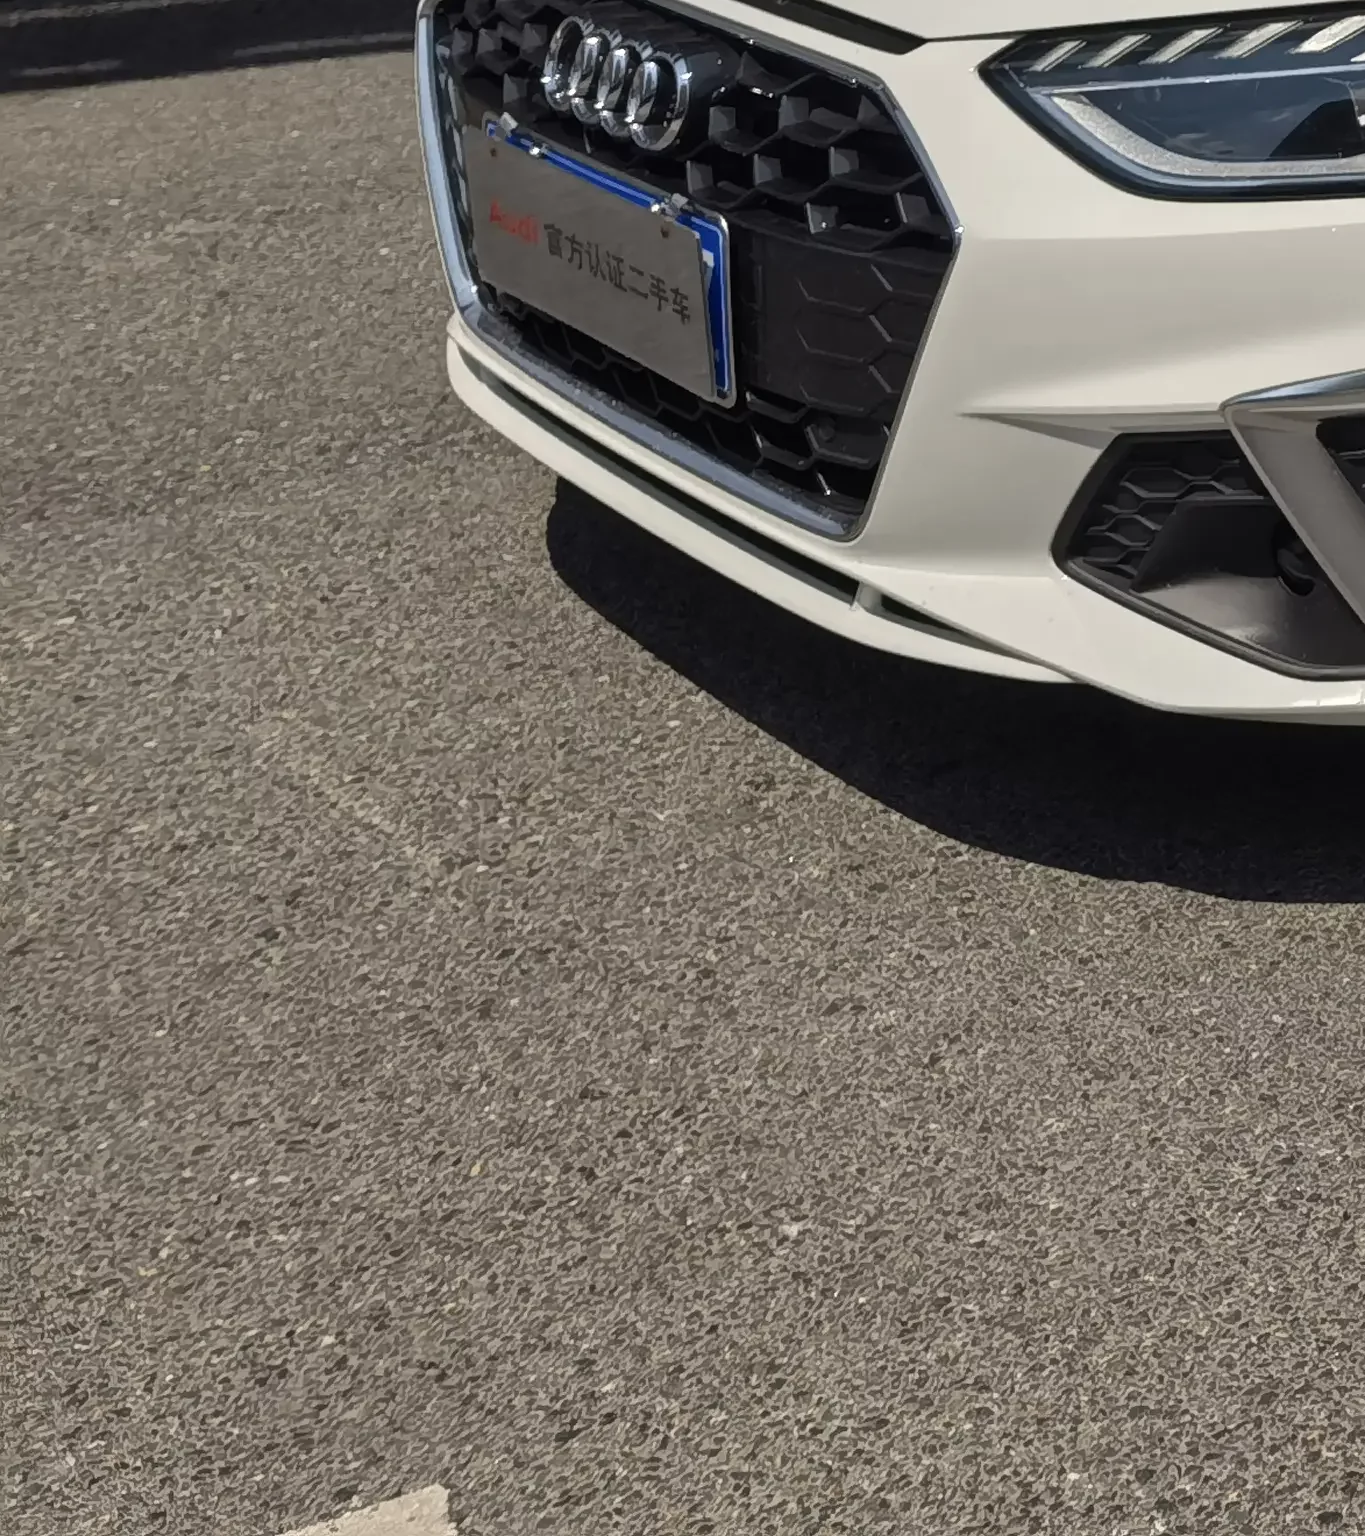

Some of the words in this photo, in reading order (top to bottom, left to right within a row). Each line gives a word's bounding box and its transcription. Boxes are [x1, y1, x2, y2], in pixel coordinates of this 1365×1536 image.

[543, 222, 691, 326] 官方认证二手车
